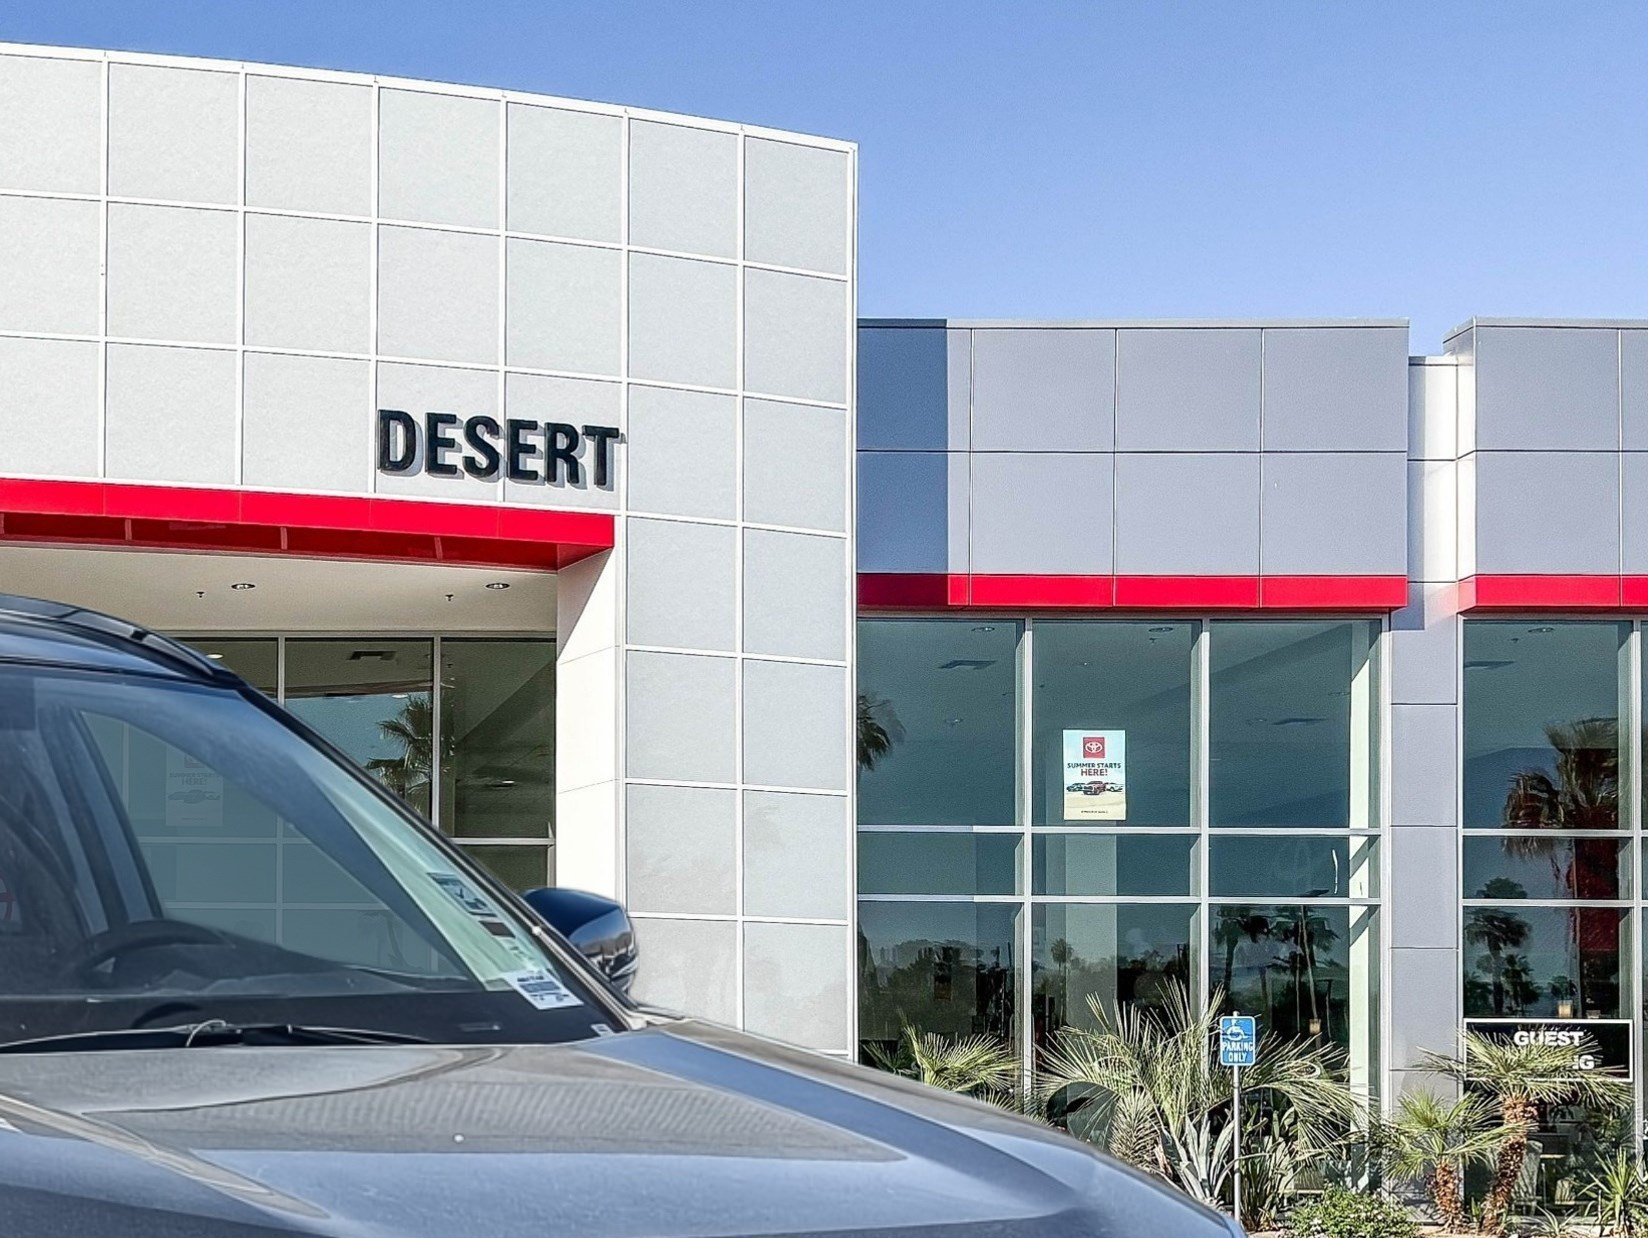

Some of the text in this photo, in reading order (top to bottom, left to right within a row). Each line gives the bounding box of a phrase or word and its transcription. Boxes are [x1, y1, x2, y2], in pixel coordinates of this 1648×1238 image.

[377, 409, 620, 487] DESERT
[1080, 768, 1108, 776] HERE!
[1513, 1030, 1585, 1047] GUEST
[1222, 1041, 1254, 1052] PARKING
[1228, 1051, 1248, 1062] ONLY
